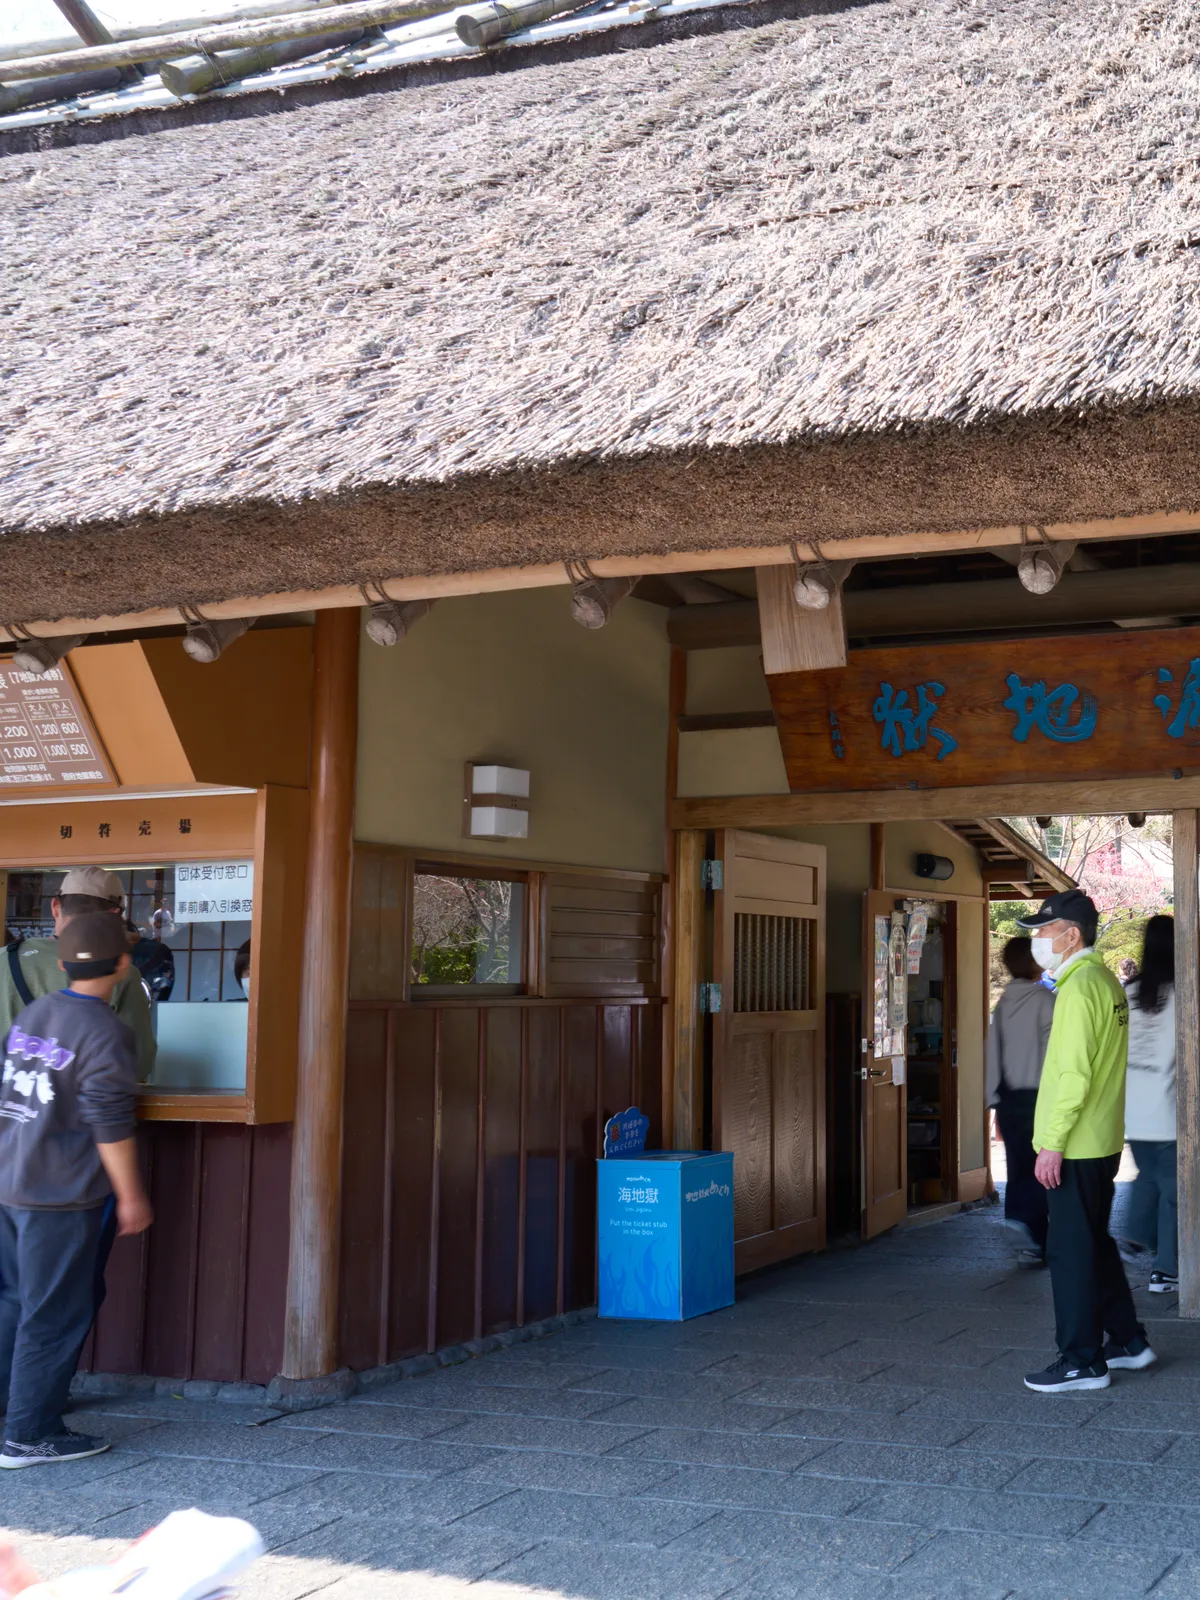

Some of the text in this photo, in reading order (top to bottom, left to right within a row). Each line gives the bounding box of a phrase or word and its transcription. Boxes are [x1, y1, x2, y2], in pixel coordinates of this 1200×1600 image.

[35, 723, 59, 736] 1,200
[61, 722, 80, 734] 600
[4, 746, 37, 759] 1,000
[44, 744, 67, 757] 1,000
[70, 743, 89, 755] 500
[178, 865, 248, 881] 団体受付窓口
[178, 899, 253, 914] 事前購入引換窓
[617, 1186, 659, 1204] 海地獄
[610, 1219, 621, 1227] Put
[621, 1219, 632, 1227] the
[633, 1220, 652, 1228] ticket
